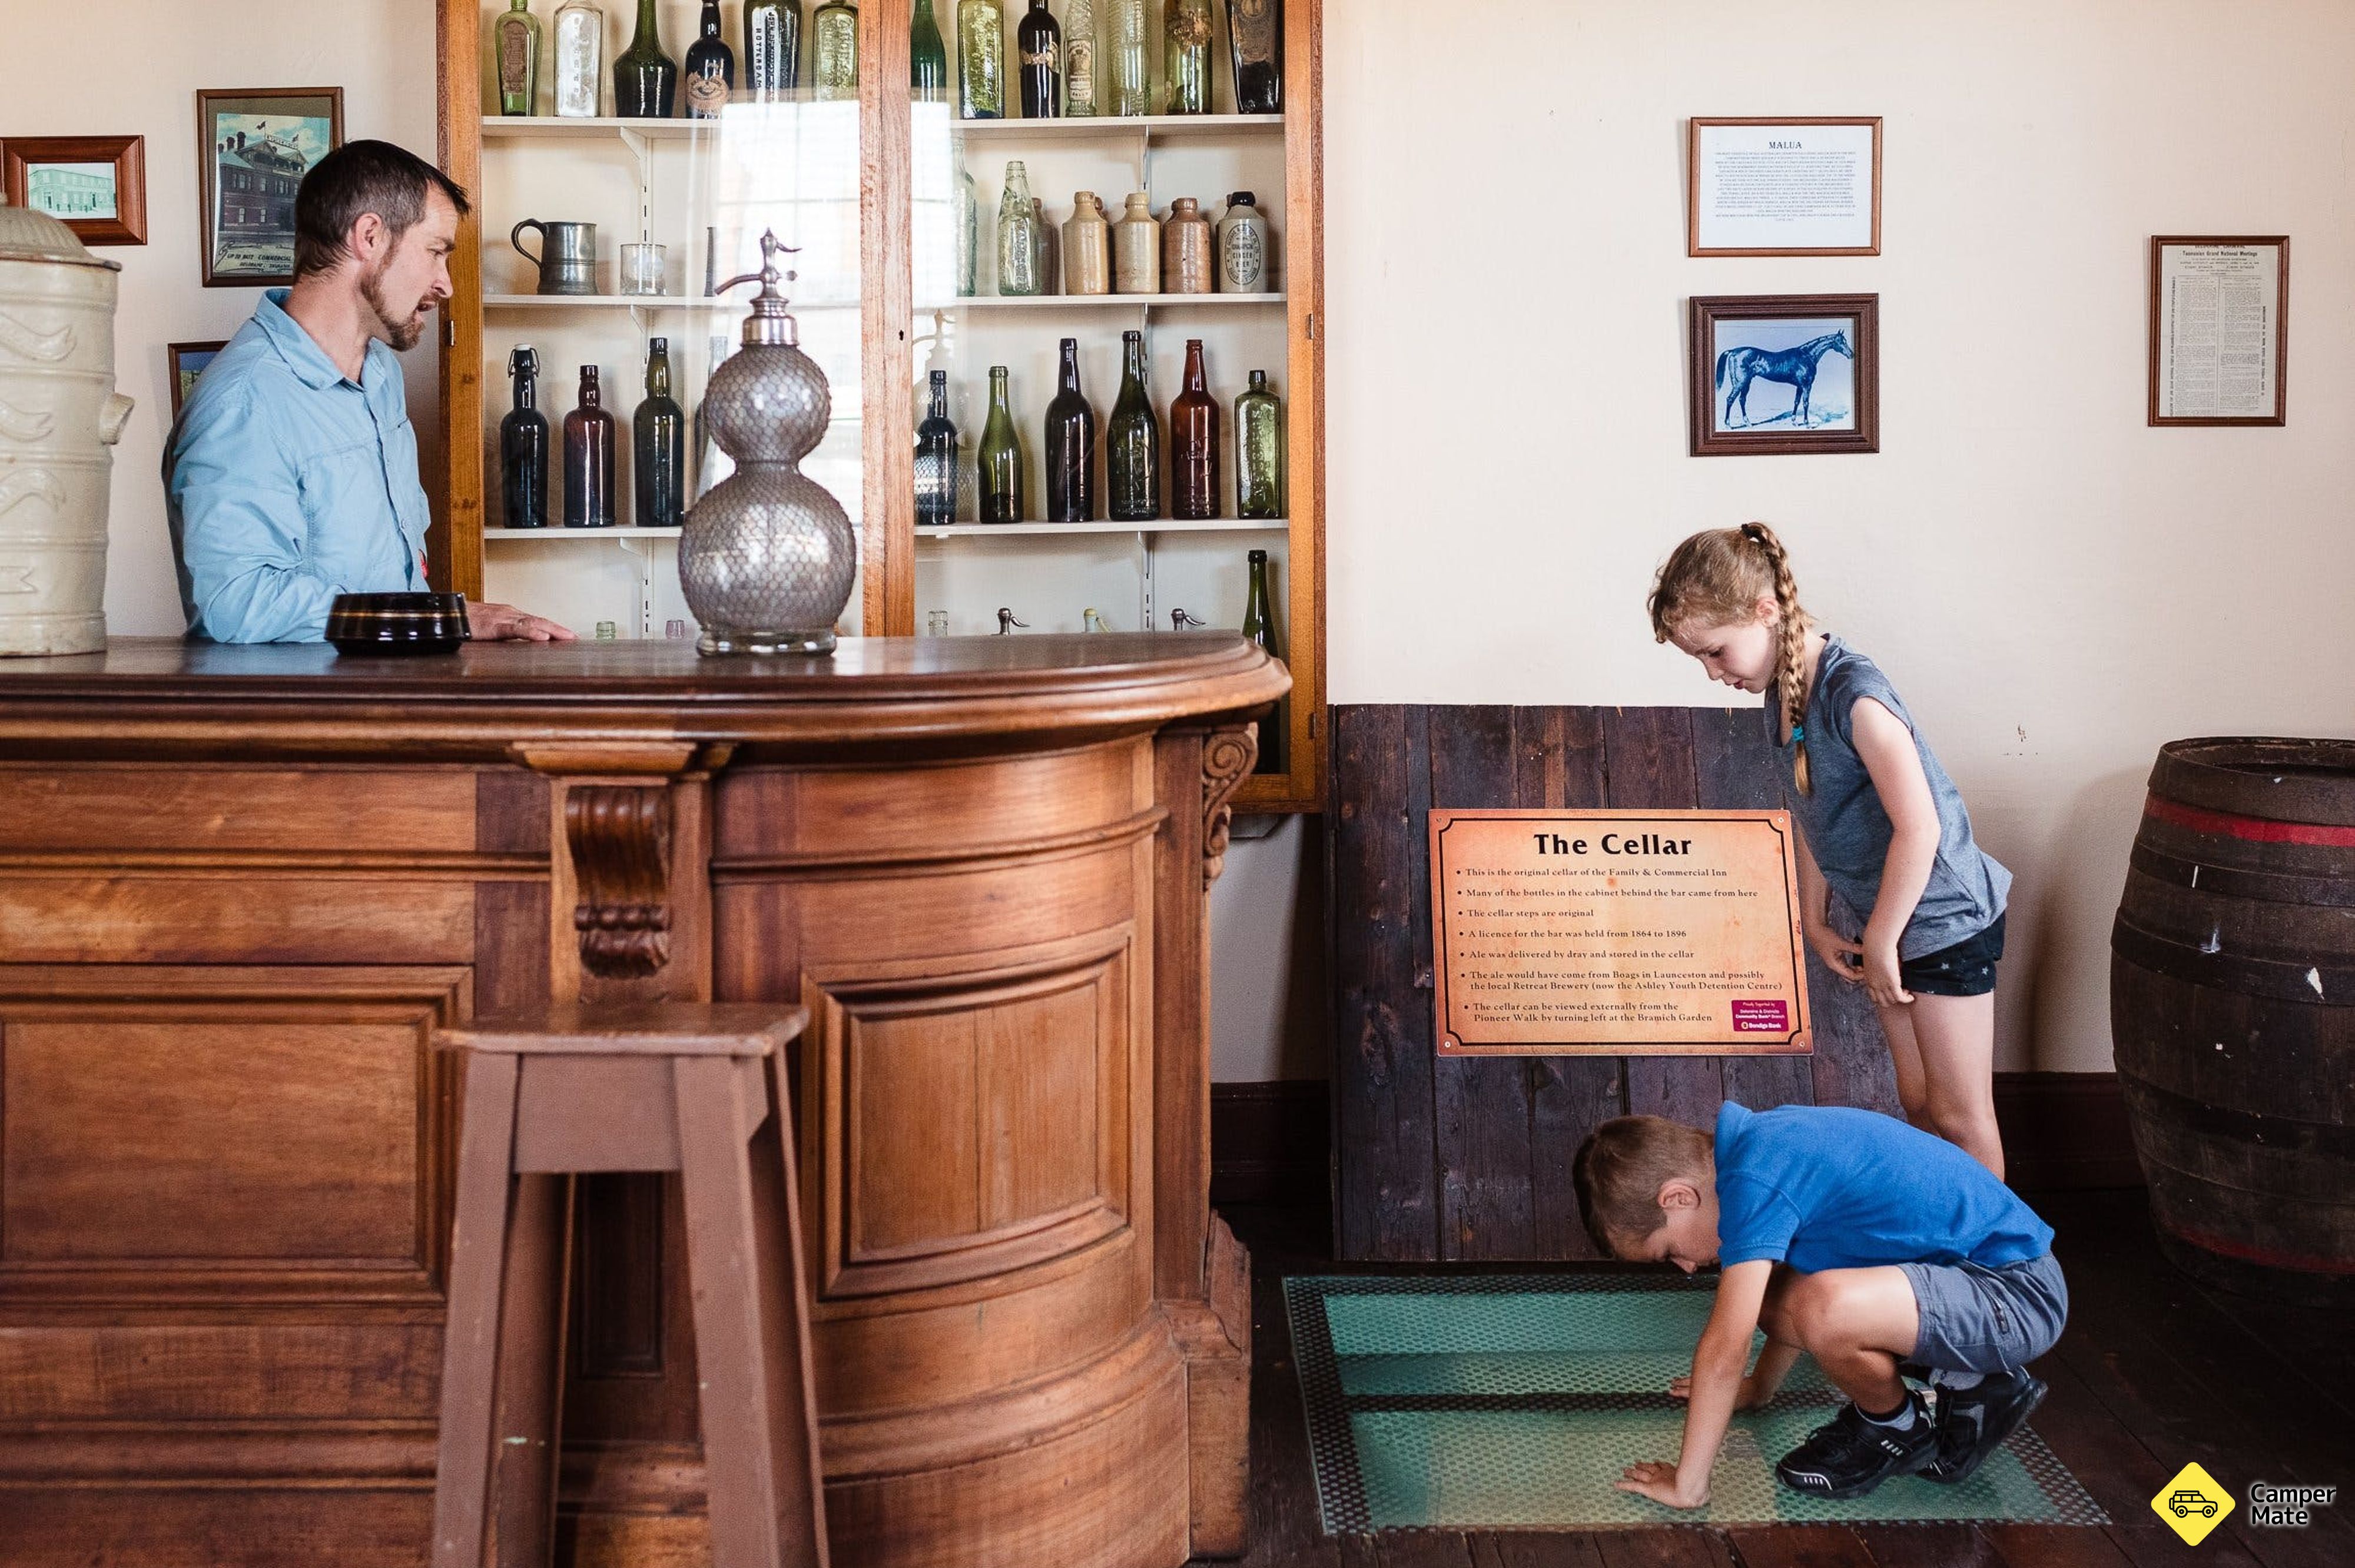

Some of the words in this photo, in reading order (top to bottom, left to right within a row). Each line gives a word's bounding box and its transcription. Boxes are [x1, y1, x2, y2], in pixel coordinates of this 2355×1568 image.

[1769, 141, 1802, 150] MALUA
[1534, 835, 1587, 854] The
[1601, 834, 1691, 855] Cellar
[1514, 869, 1549, 877] original
[1609, 868, 1640, 876] Family
[1654, 868, 1709, 876] Commercial
[1467, 889, 1492, 898] Many
[1516, 909, 1538, 919] steps
[1558, 909, 1594, 919] original
[1470, 950, 1485, 958] Ale
[1508, 950, 1551, 958] delivered
[1554, 950, 1564, 959] by
[1567, 950, 1587, 959] dray
[1590, 950, 1606, 958] and
[1609, 950, 1638, 958] stored
[1640, 950, 1648, 958] in
[1651, 950, 1666, 958] the
[1669, 950, 1694, 958] cellar
[1470, 971, 1487, 979] The
[1490, 971, 1504, 979] ale
[1507, 971, 1534, 979] would
[1537, 971, 1558, 979] have
[1588, 971, 1610, 979] from
[1613, 971, 1640, 981] Boags
[1642, 971, 1651, 979] in
[1654, 971, 1706, 979] Launceston
[1709, 971, 1727, 979] and
[1729, 971, 1765, 981] possibly
[1550, 982, 1589, 991] Brewery
[1592, 982, 1614, 991] (now
[1635, 982, 1666, 991] Ashley
[1747, 982, 1782, 991] Centre)
[1590, 1003, 1637, 1012] externally
[1541, 1014, 1551, 1023] by
[1555, 1014, 1588, 1023] turning
